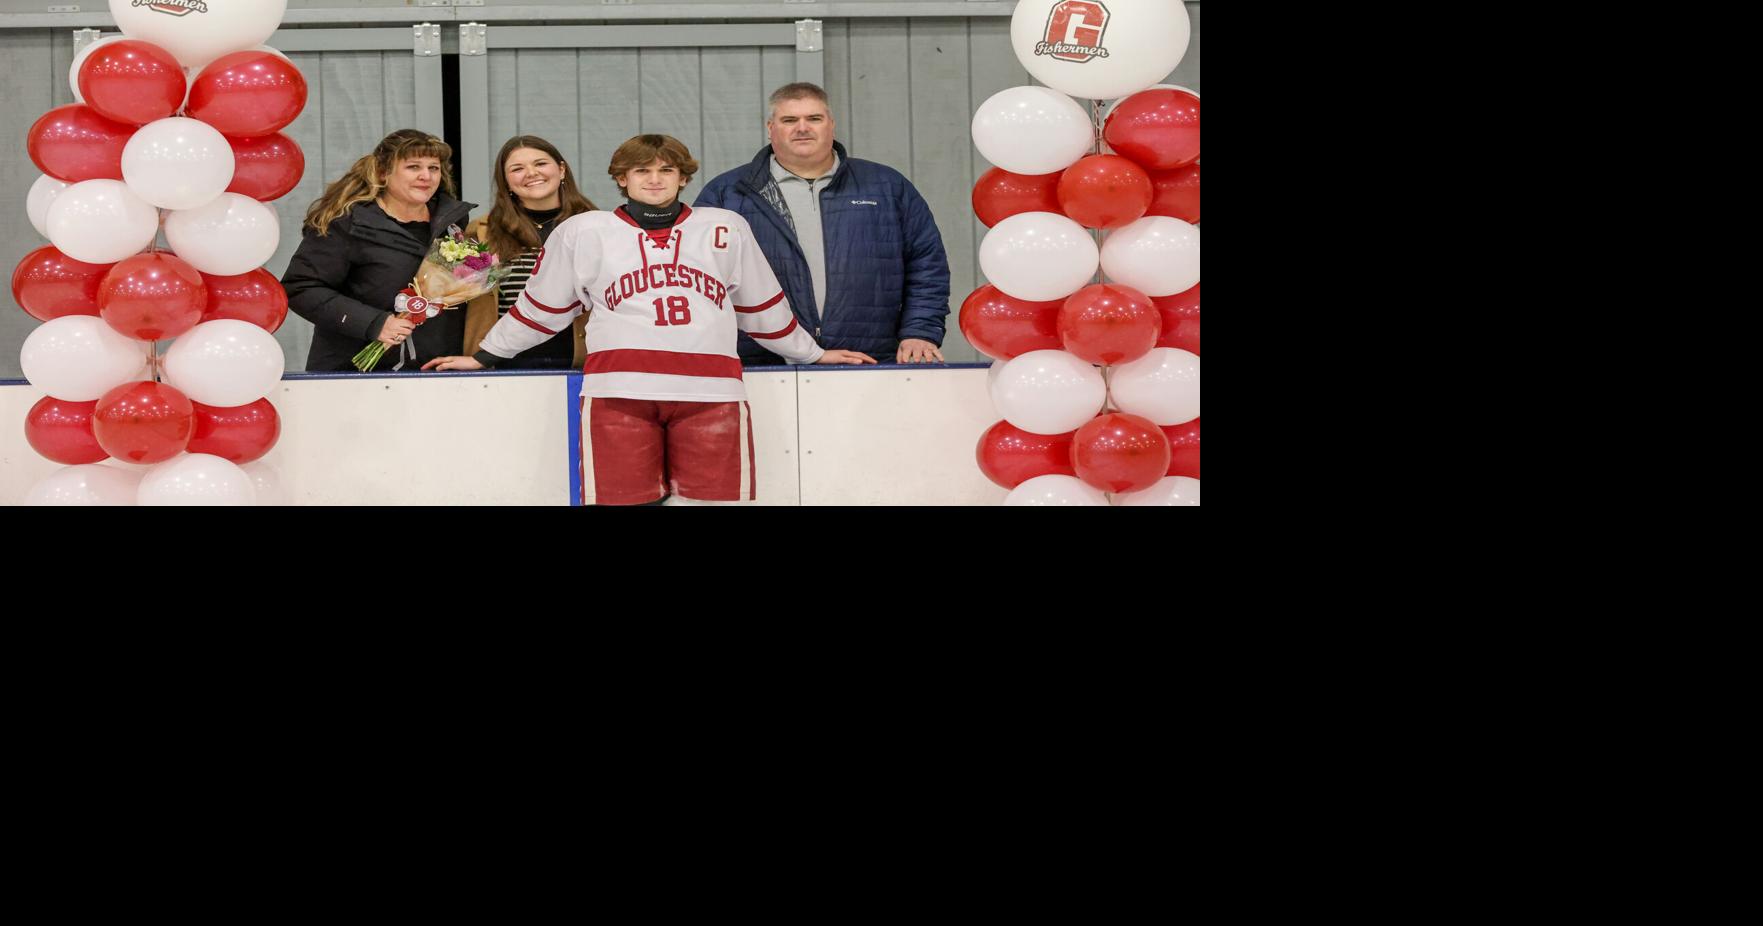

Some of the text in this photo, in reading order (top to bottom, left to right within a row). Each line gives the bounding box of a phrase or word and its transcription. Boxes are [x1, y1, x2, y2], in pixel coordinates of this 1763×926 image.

[1045, 0, 1108, 62] G
[1034, 41, 1109, 58] Fishermen
[714, 226, 728, 249] C
[604, 263, 726, 311] GLOUCESTER
[411, 299, 424, 310] 18
[652, 295, 691, 326] 18
